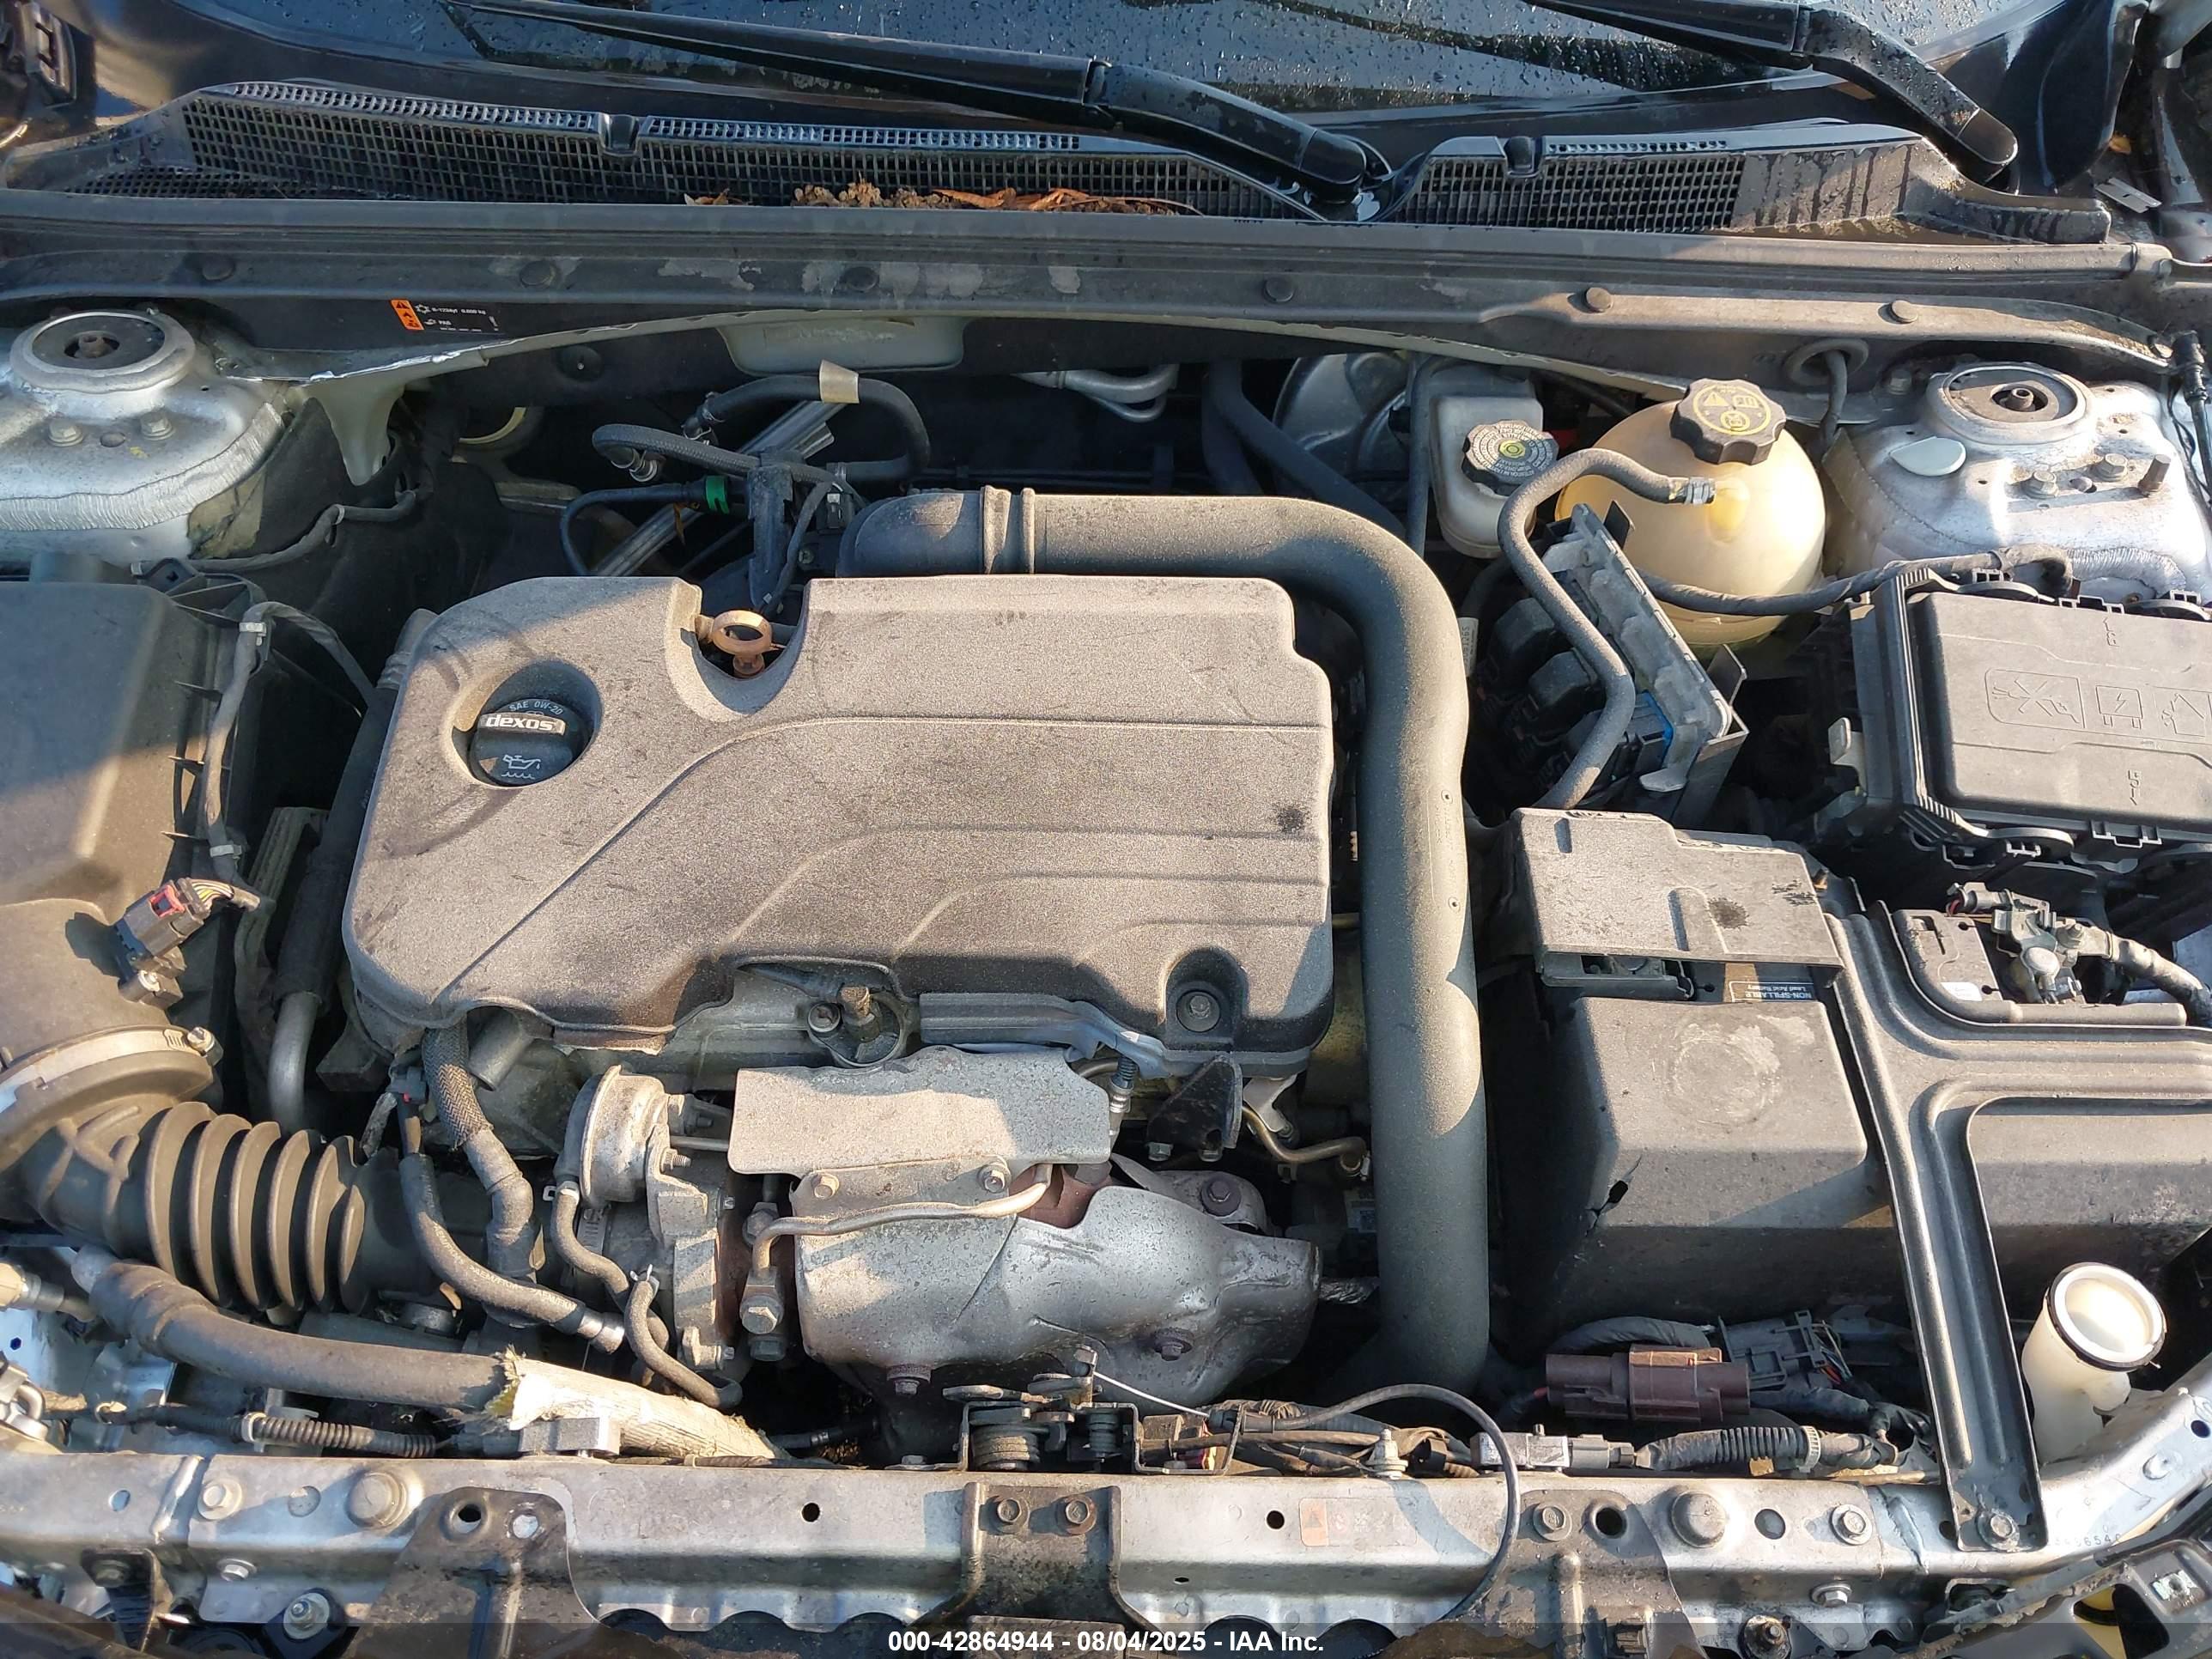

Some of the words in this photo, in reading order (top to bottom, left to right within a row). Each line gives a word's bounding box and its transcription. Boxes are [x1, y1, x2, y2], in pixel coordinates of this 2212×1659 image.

[509, 702, 529, 711] SAE
[534, 701, 563, 715] 0W-20
[485, 714, 554, 730] dexos
